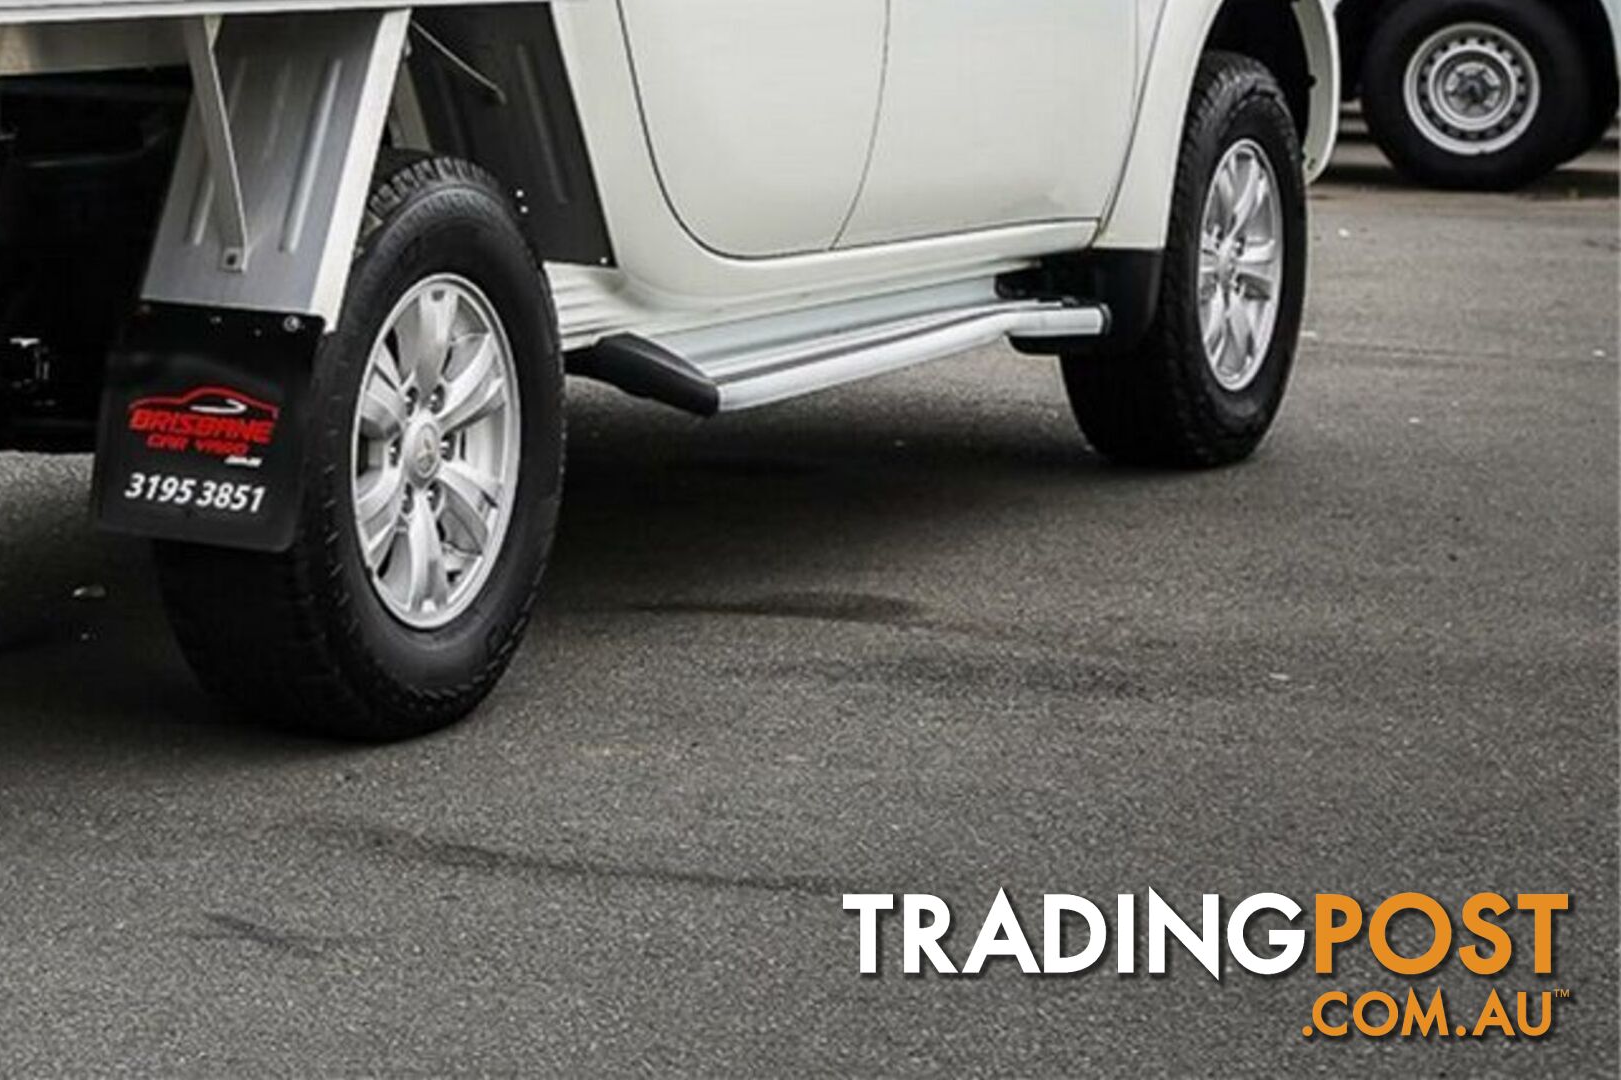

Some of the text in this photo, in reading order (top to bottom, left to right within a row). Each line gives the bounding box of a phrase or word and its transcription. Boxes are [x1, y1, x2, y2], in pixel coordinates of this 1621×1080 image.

[130, 409, 275, 444] BRISBANE
[124, 472, 266, 513] 3195 3851
